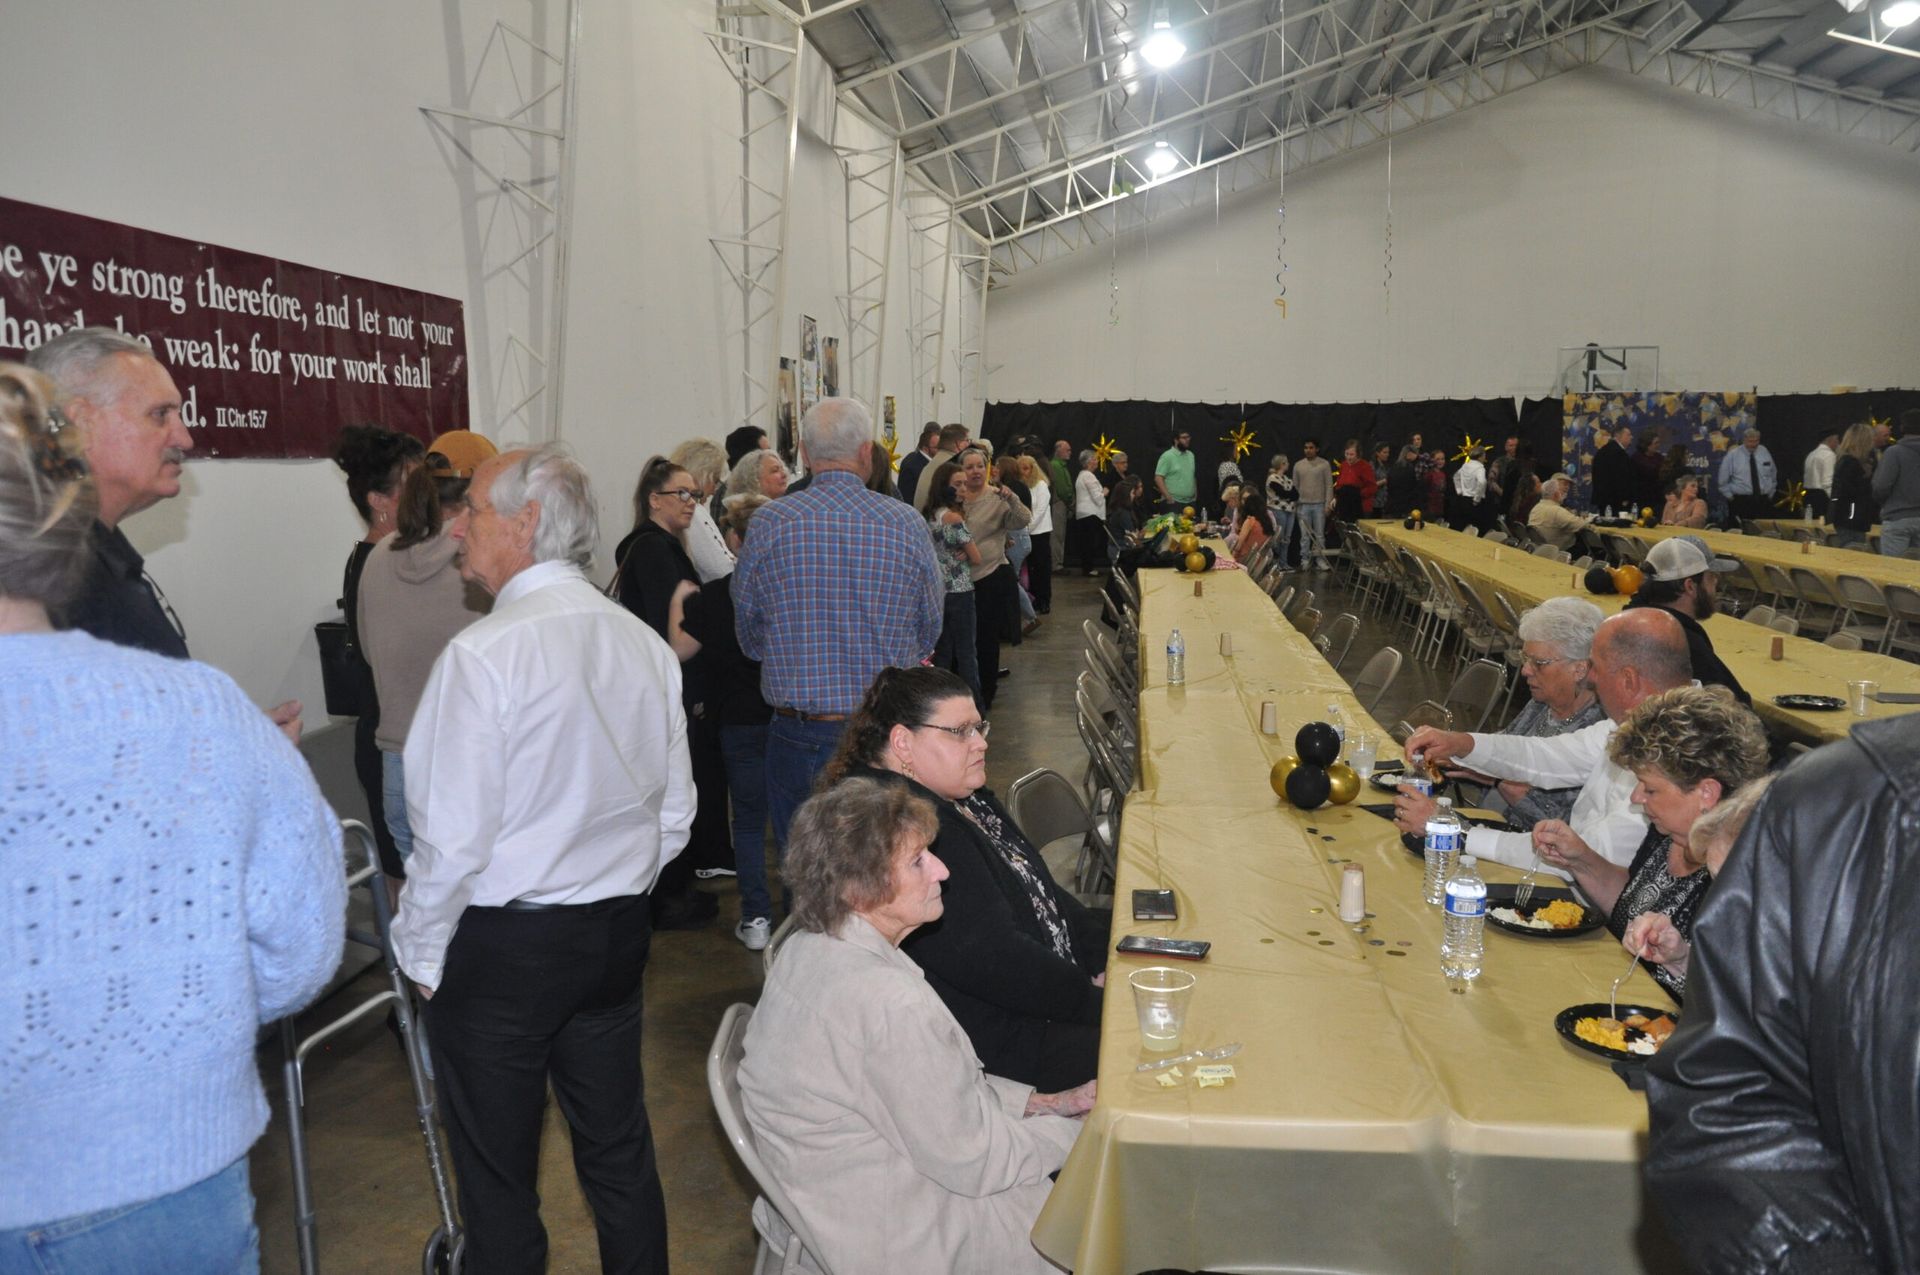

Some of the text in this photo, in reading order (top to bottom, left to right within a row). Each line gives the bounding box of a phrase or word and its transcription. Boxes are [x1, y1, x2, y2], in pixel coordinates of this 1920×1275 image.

[39, 252, 78, 295] ye
[92, 258, 187, 314] strong
[195, 267, 308, 331] therefore,
[315, 294, 350, 330] and
[357, 297, 381, 335] let
[387, 315, 414, 340] not
[421, 321, 454, 350] your
[164, 328, 240, 371] weak:
[249, 332, 282, 375] for
[290, 352, 336, 386] your
[342, 350, 388, 385] work
[394, 353, 432, 388] shall
[216, 407, 268, 429] II Chr. 15:7
